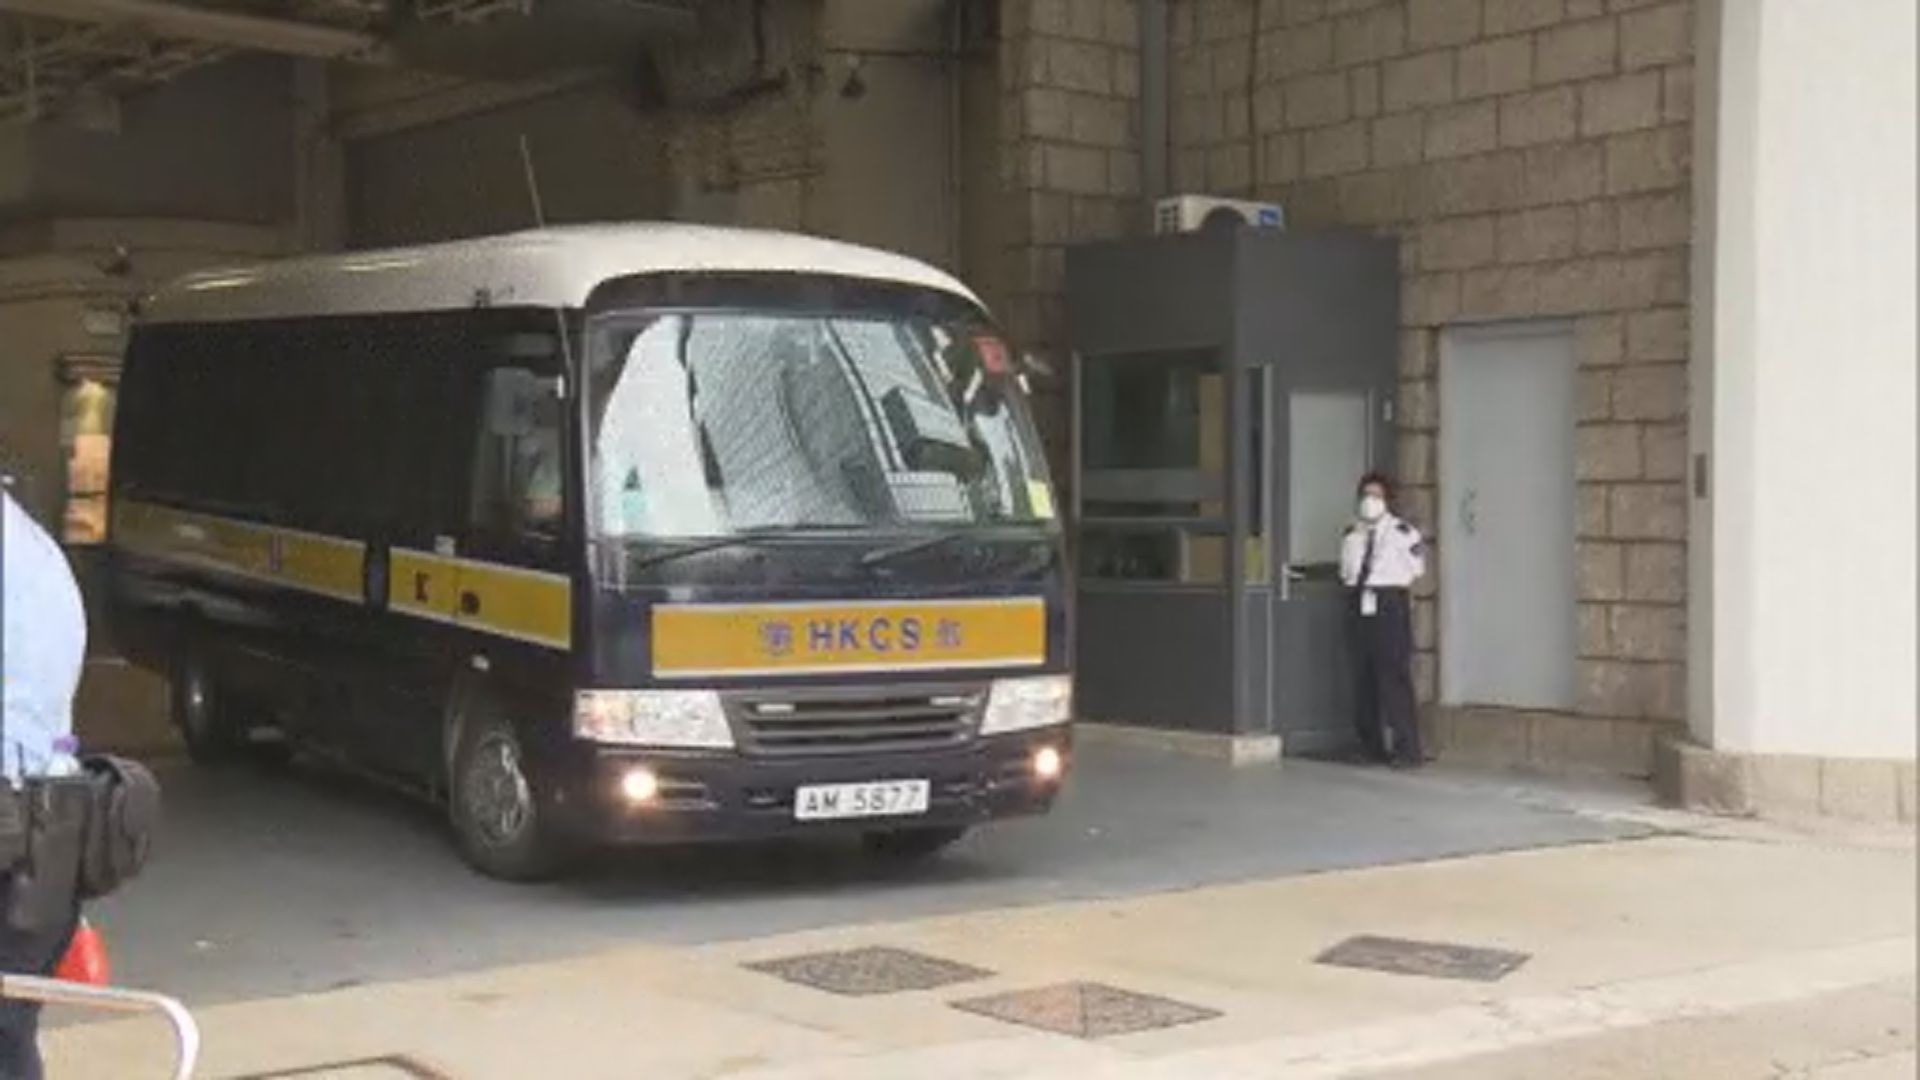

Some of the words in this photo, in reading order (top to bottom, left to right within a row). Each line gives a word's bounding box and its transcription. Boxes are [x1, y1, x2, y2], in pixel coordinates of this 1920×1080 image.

[809, 617, 921, 651] HKCS
[806, 790, 839, 812] AM
[854, 785, 920, 811] 5877
